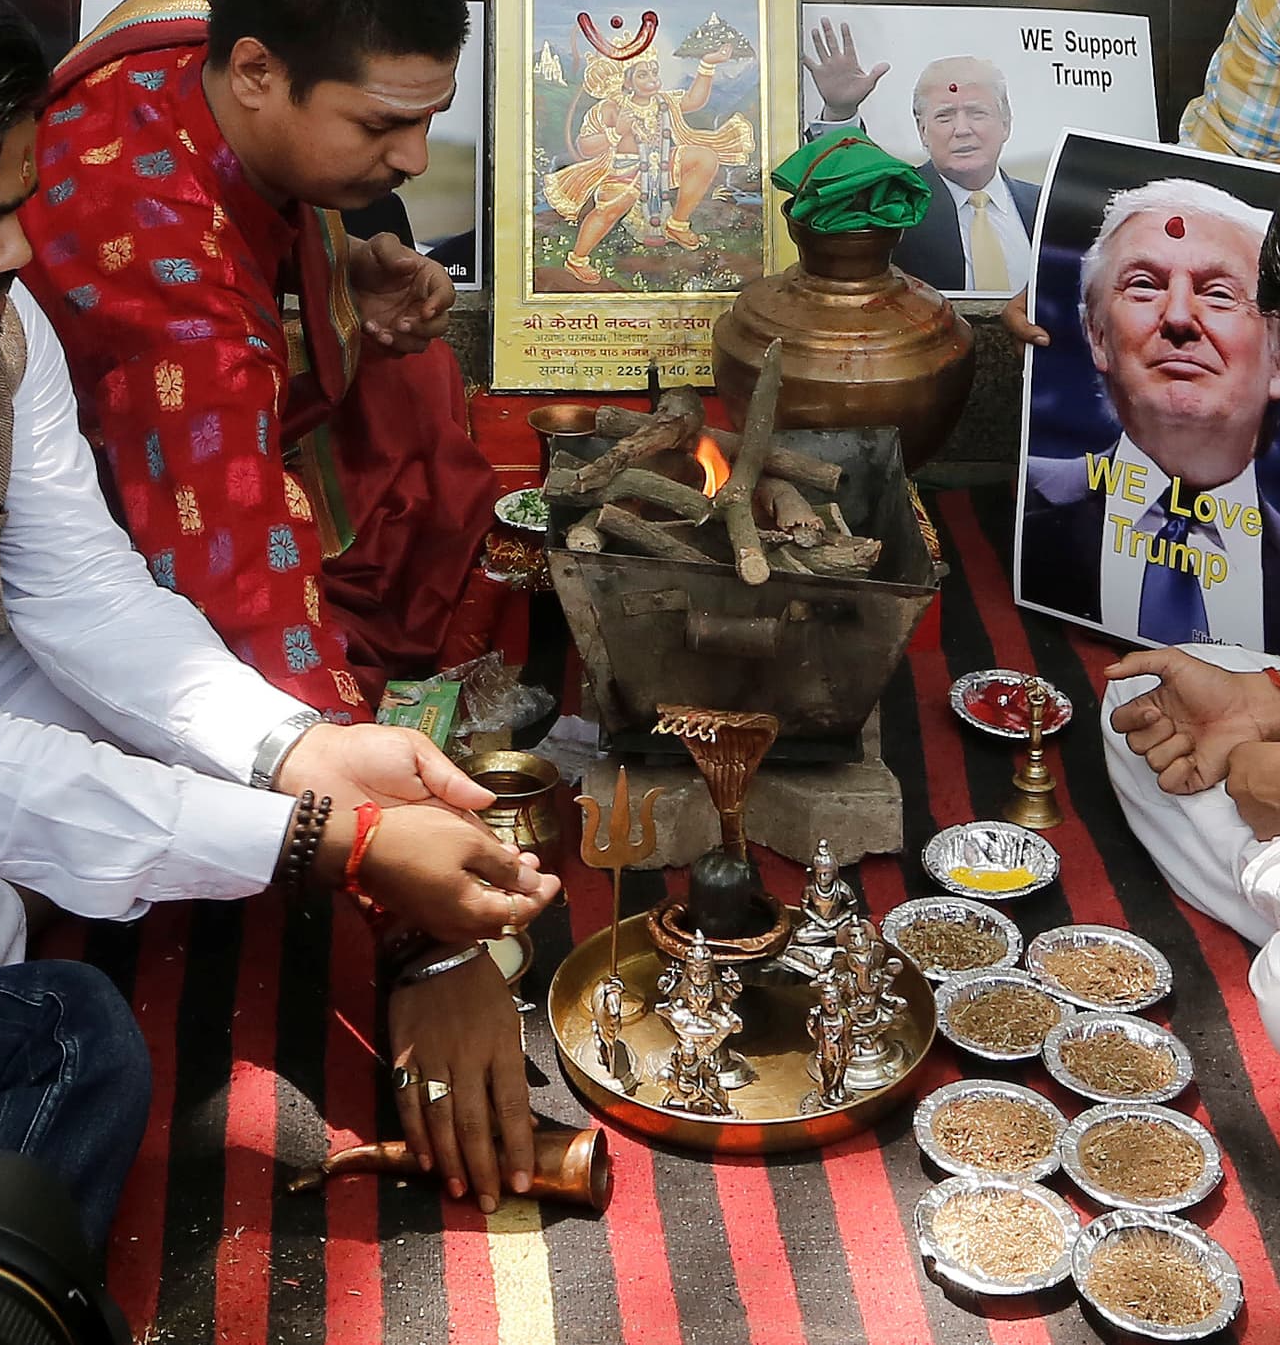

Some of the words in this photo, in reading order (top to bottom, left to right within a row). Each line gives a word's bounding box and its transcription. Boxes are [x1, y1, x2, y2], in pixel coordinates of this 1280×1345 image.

[1020, 27, 1054, 52] WE
[1064, 29, 1138, 60] Support
[1051, 62, 1113, 93] Trump
[522, 314, 543, 330] श्री
[550, 312, 598, 330] केसरी
[604, 317, 651, 330] नन्दन
[616, 365, 689, 377] 2257140,
[1085, 451, 1149, 505] WE
[1169, 476, 1263, 537] Love
[1108, 513, 1228, 590] Trump
